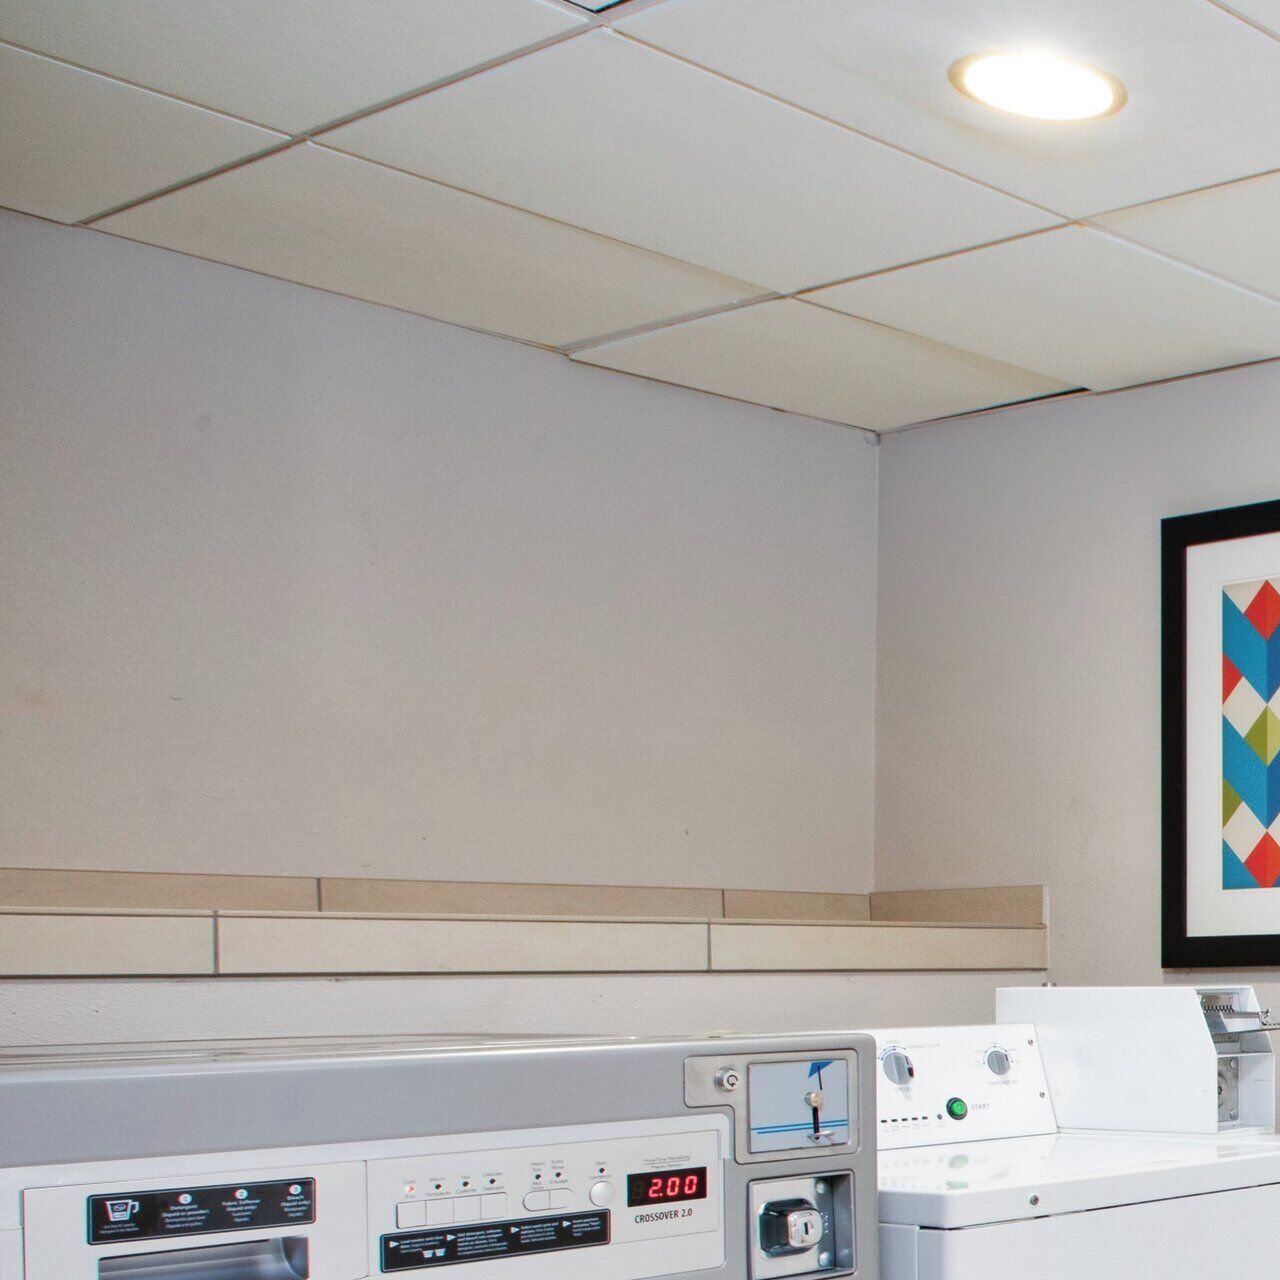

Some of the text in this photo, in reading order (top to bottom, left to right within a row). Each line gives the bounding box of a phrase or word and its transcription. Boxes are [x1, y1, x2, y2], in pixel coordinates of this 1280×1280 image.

[648, 1175, 698, 1198] 2.00
[634, 1208, 693, 1224] CROSSOVER 2.0
